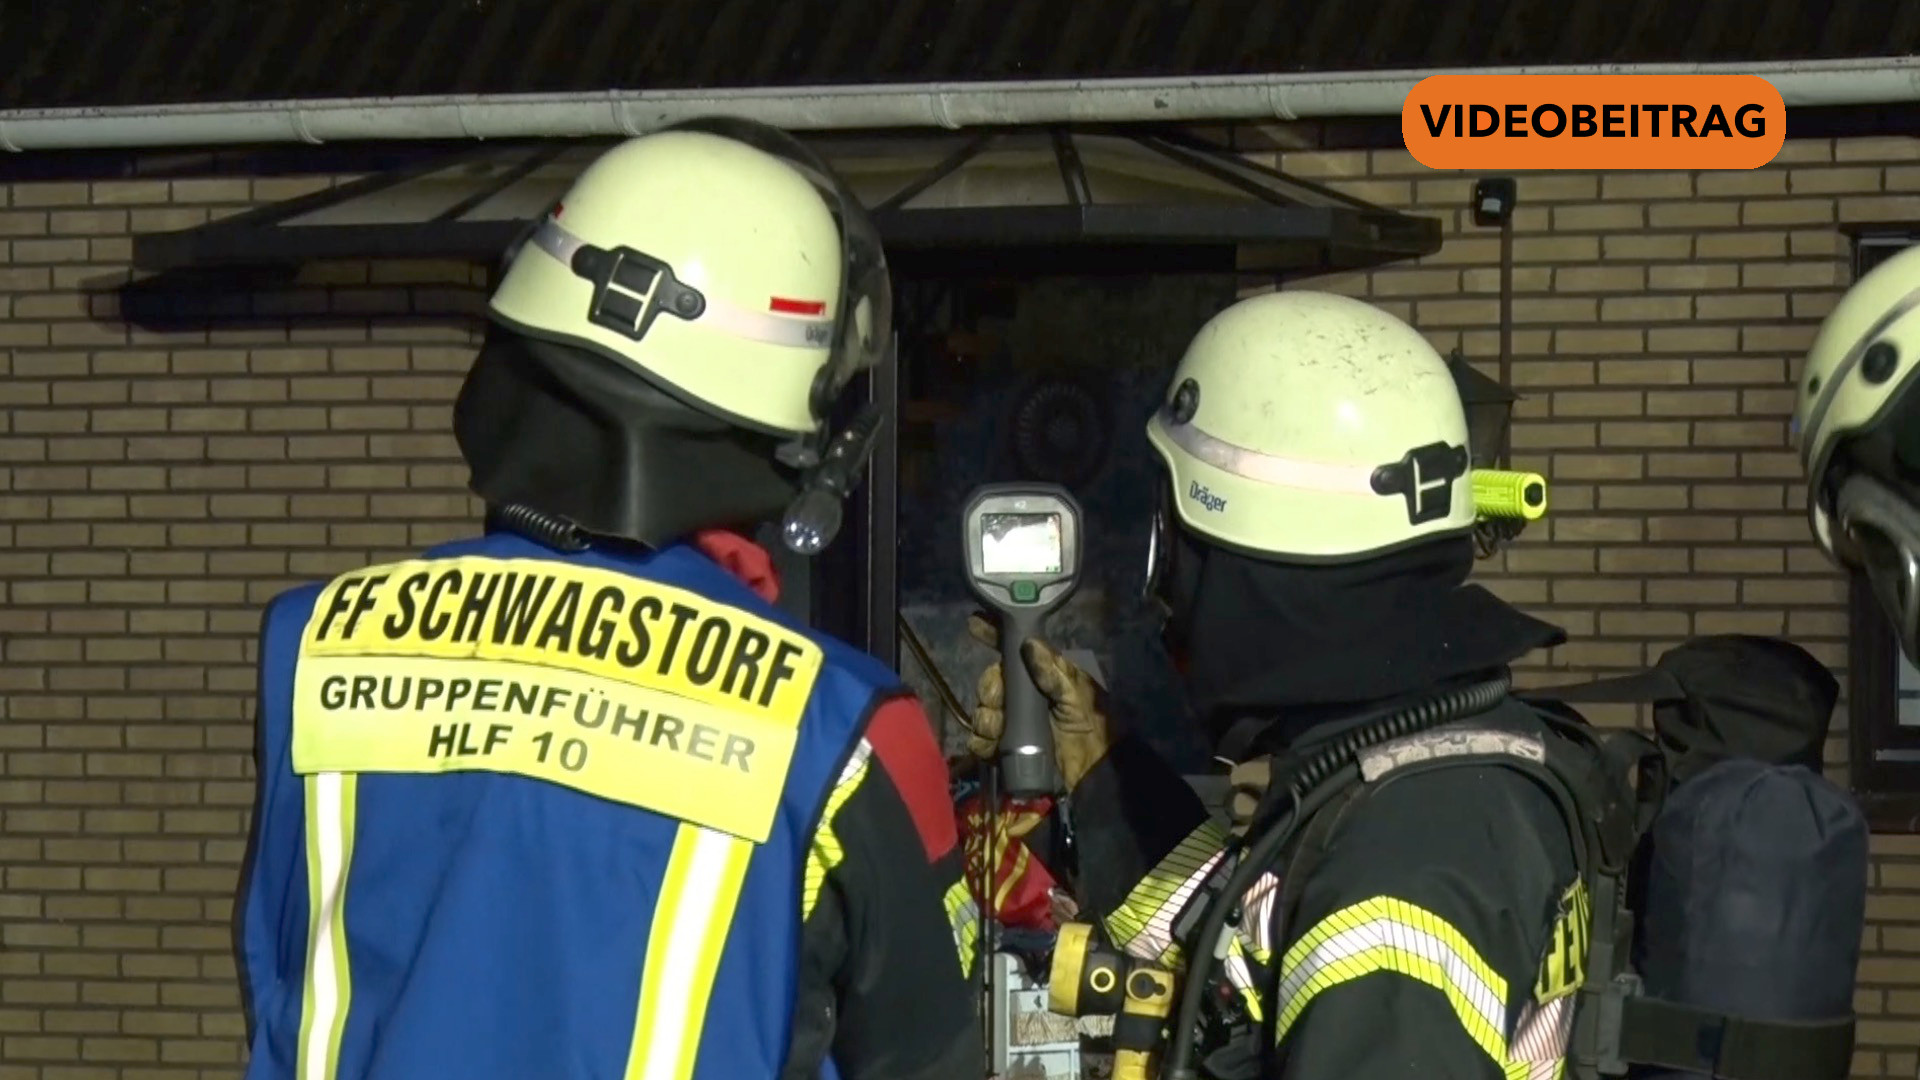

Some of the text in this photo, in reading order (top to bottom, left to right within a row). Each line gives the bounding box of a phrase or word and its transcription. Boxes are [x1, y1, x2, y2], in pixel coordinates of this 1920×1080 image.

[1189, 480, 1227, 512] Dräger
[316, 569, 804, 708] FF SCHWAGSTORF
[320, 675, 757, 773] GRUPPENFÜHRER
[428, 724, 589, 773] HLF 10
